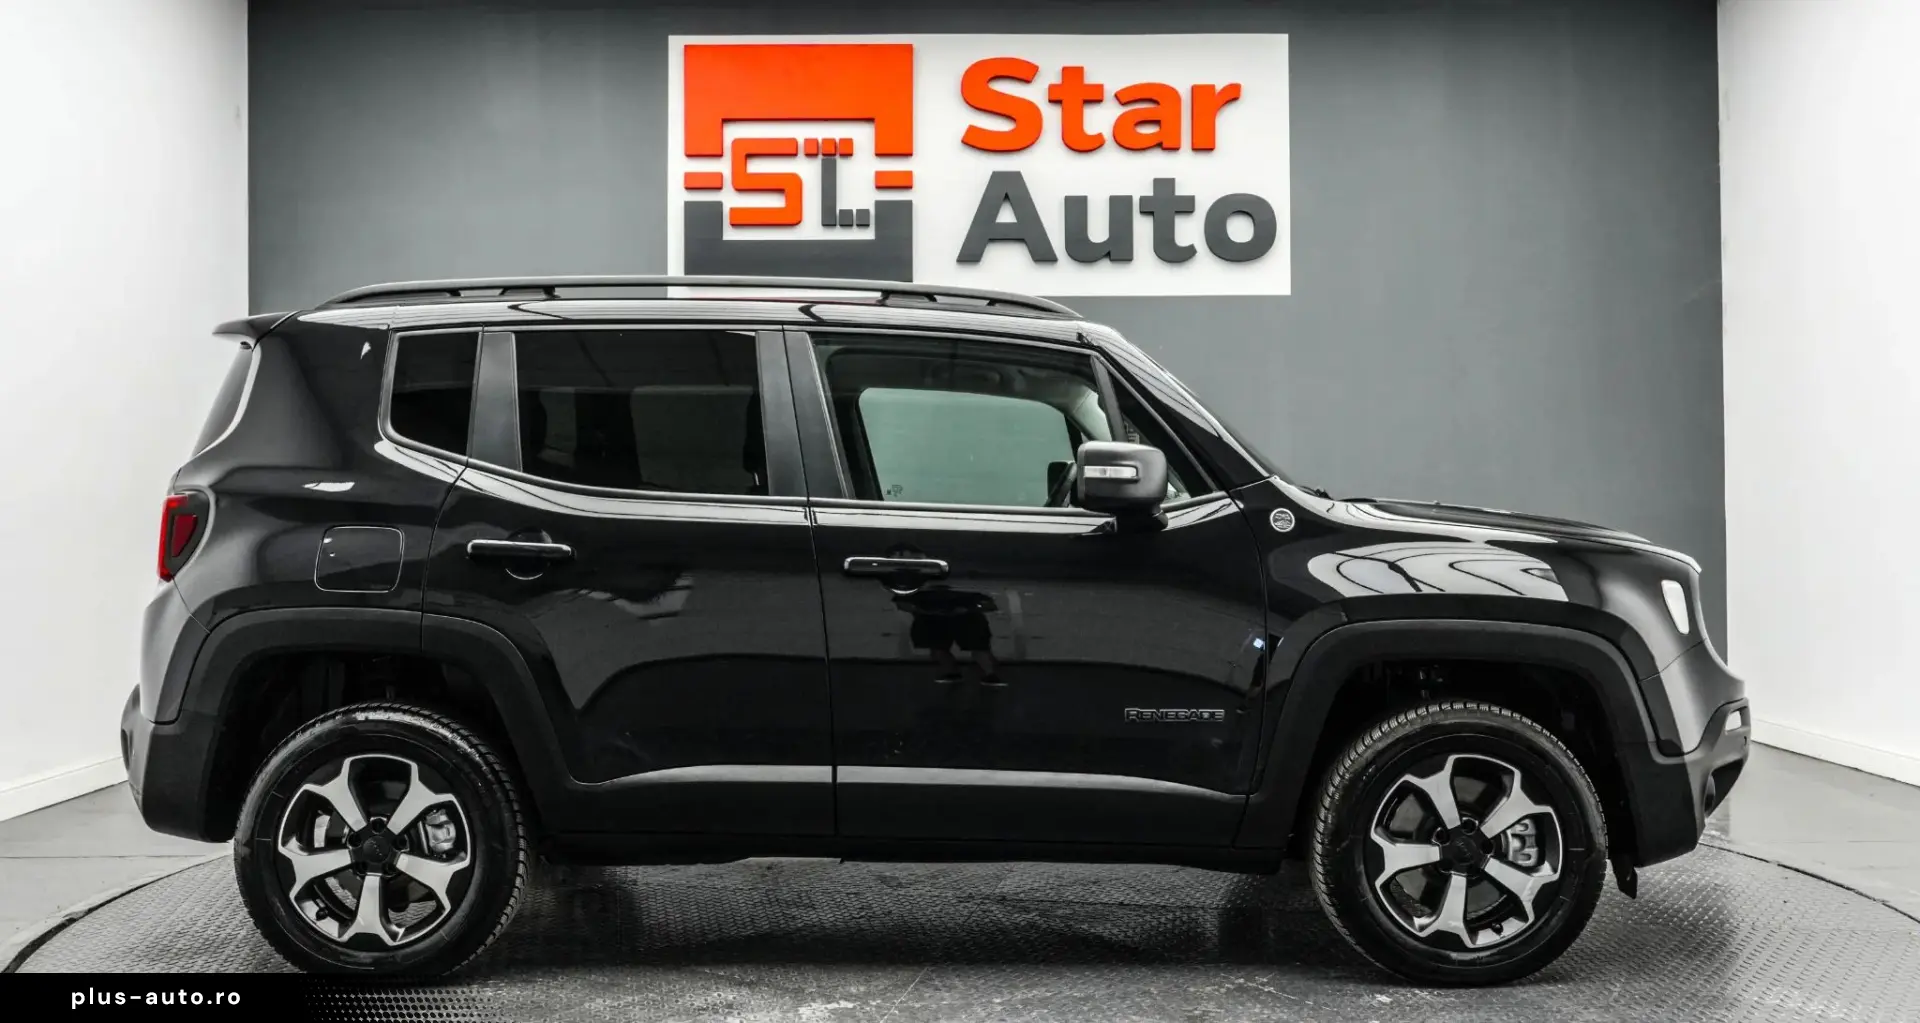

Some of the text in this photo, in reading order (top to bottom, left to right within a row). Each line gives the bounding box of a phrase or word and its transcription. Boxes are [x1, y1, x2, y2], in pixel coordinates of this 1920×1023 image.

[959, 57, 1242, 153] Star
[956, 170, 1278, 264] Auto
[1125, 707, 1225, 722] RENEGADE
